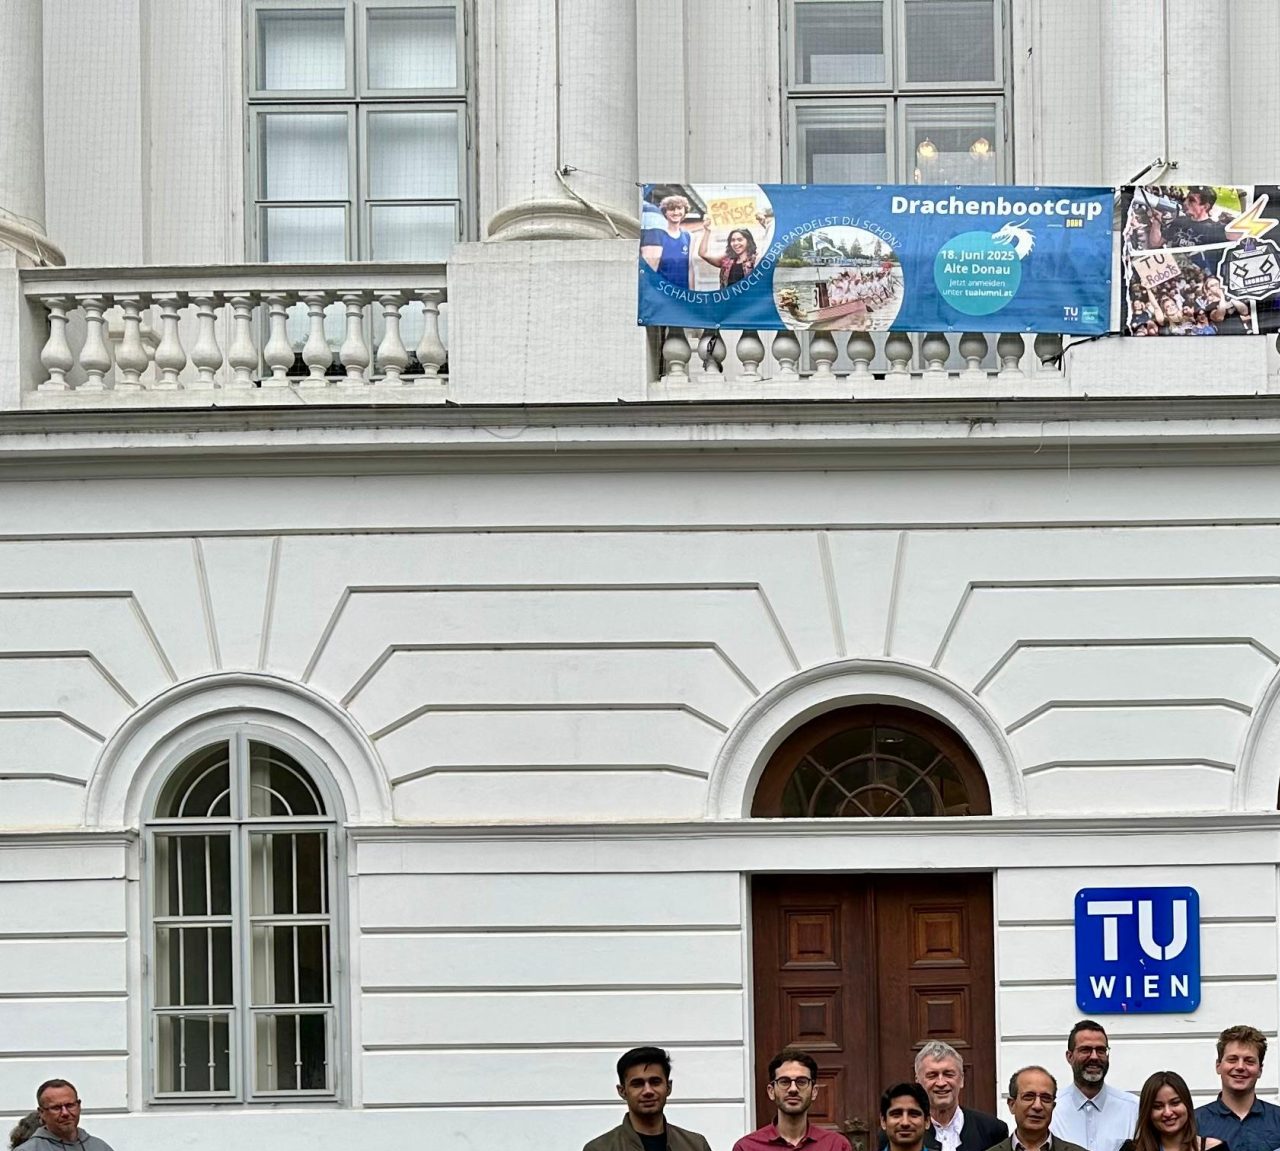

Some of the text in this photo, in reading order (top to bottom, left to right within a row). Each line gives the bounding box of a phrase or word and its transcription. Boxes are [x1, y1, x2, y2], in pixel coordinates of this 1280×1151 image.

[891, 196, 1102, 220] DrachenbootCup
[656, 215, 903, 304] SCHAUST DU NOCH ODER PADDELST DU SCHON?
[941, 249, 1015, 261] 18. Juni 2025
[944, 264, 1010, 275] Alte Donau
[948, 278, 1006, 288] jetzt anmelden
[942, 289, 1013, 298] unter tualumni.at
[1064, 307, 1078, 317] TU
[1087, 900, 1188, 961] TU
[1089, 974, 1189, 999] WIEN
